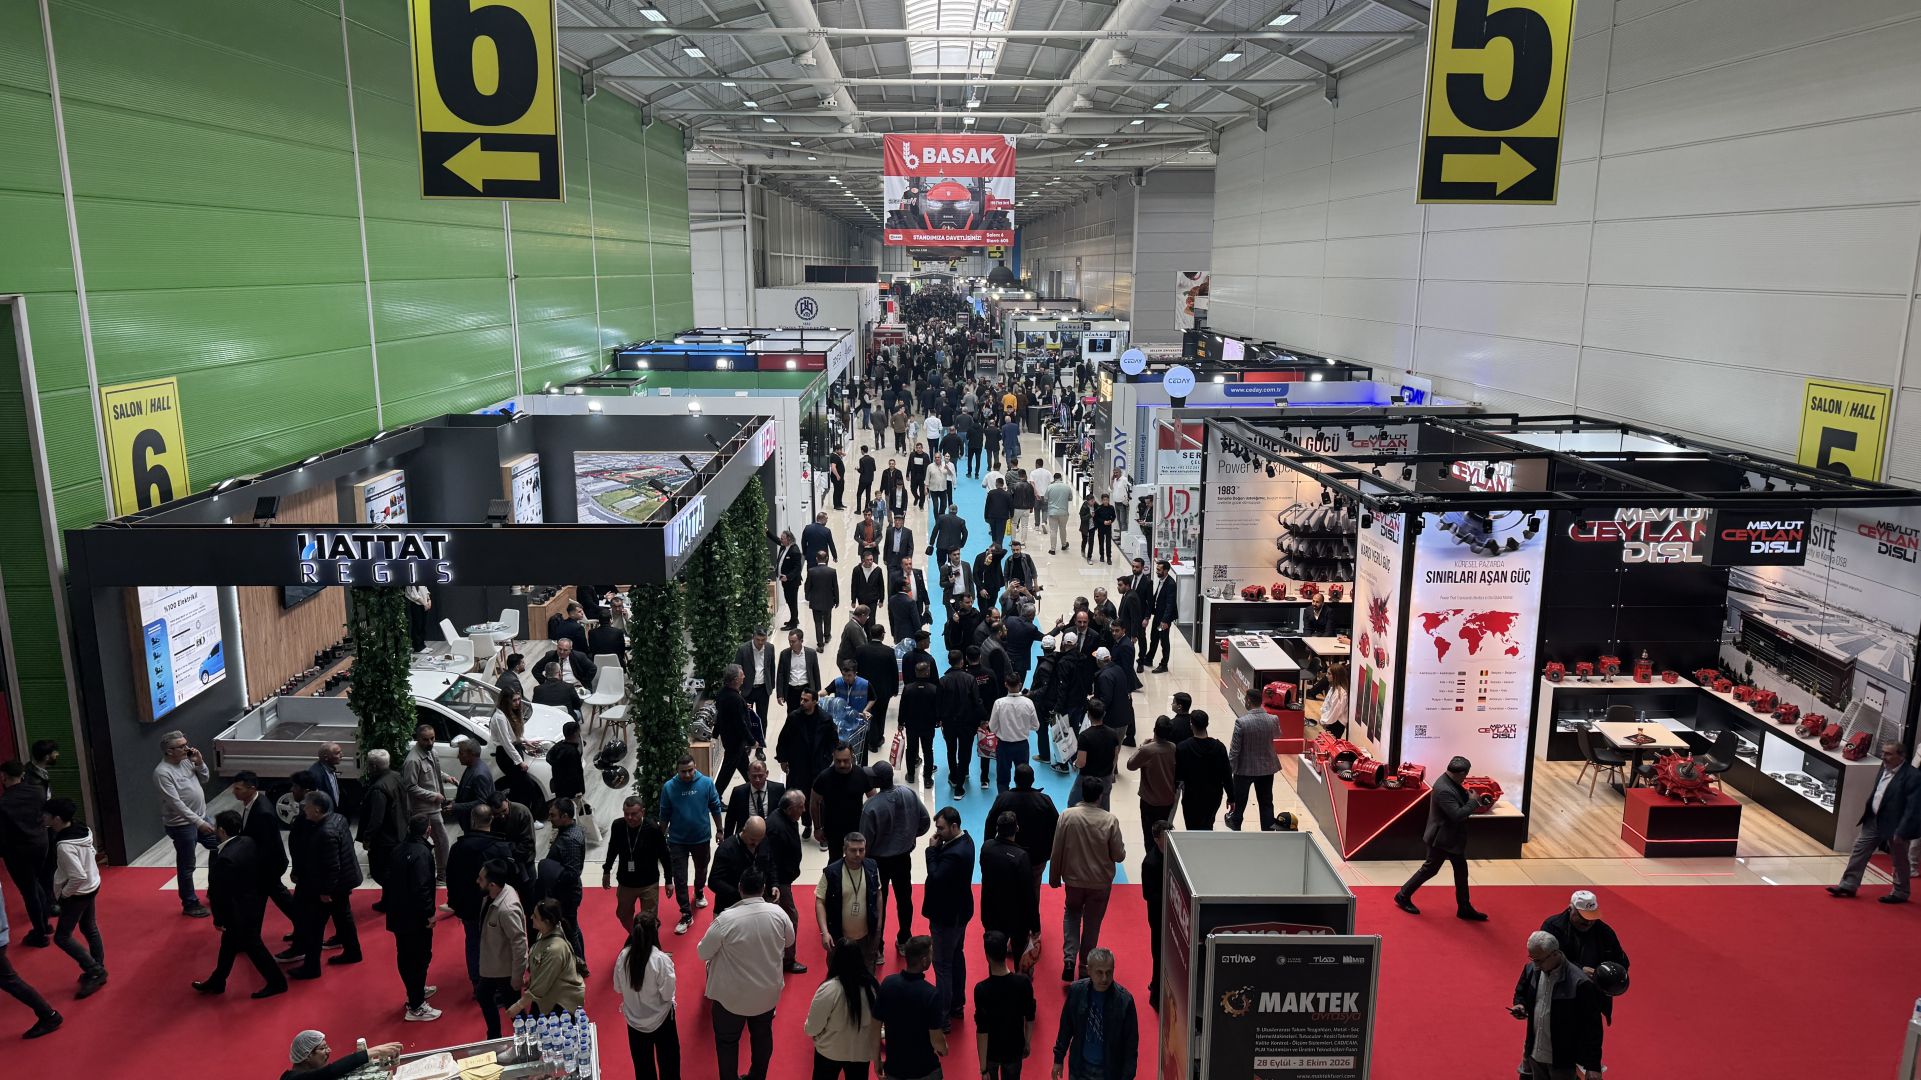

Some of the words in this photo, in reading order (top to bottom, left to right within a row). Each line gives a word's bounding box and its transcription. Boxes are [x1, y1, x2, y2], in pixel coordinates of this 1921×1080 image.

[429, 0, 538, 126] 6
[1446, 0, 1553, 131] 5
[922, 147, 997, 164] BASAK
[112, 400, 142, 420] SALON
[150, 396, 172, 413] HALL
[1810, 396, 1842, 415] SALON
[1849, 402, 1876, 420] HALL
[1352, 440, 1408, 448] CEYLAN
[132, 428, 174, 511] 6
[1218, 460, 1250, 474] Power
[1218, 486, 1236, 495] 1983
[1721, 529, 1803, 541] CEYLAN
[1858, 523, 1919, 550] CEYLAN
[297, 534, 449, 560] HATTAT
[300, 562, 452, 584] REGIS
[1425, 570, 1477, 583] SINIRLARI
[1479, 570, 1508, 586] AŞAN
[1511, 568, 1531, 585] GÜÇ
[1230, 954, 1256, 963] TÜYAP
[1258, 992, 1360, 1013] MAKTEK
[1312, 1013, 1360, 1023] avrasya
[1270, 1059, 1291, 1068] Eylül
